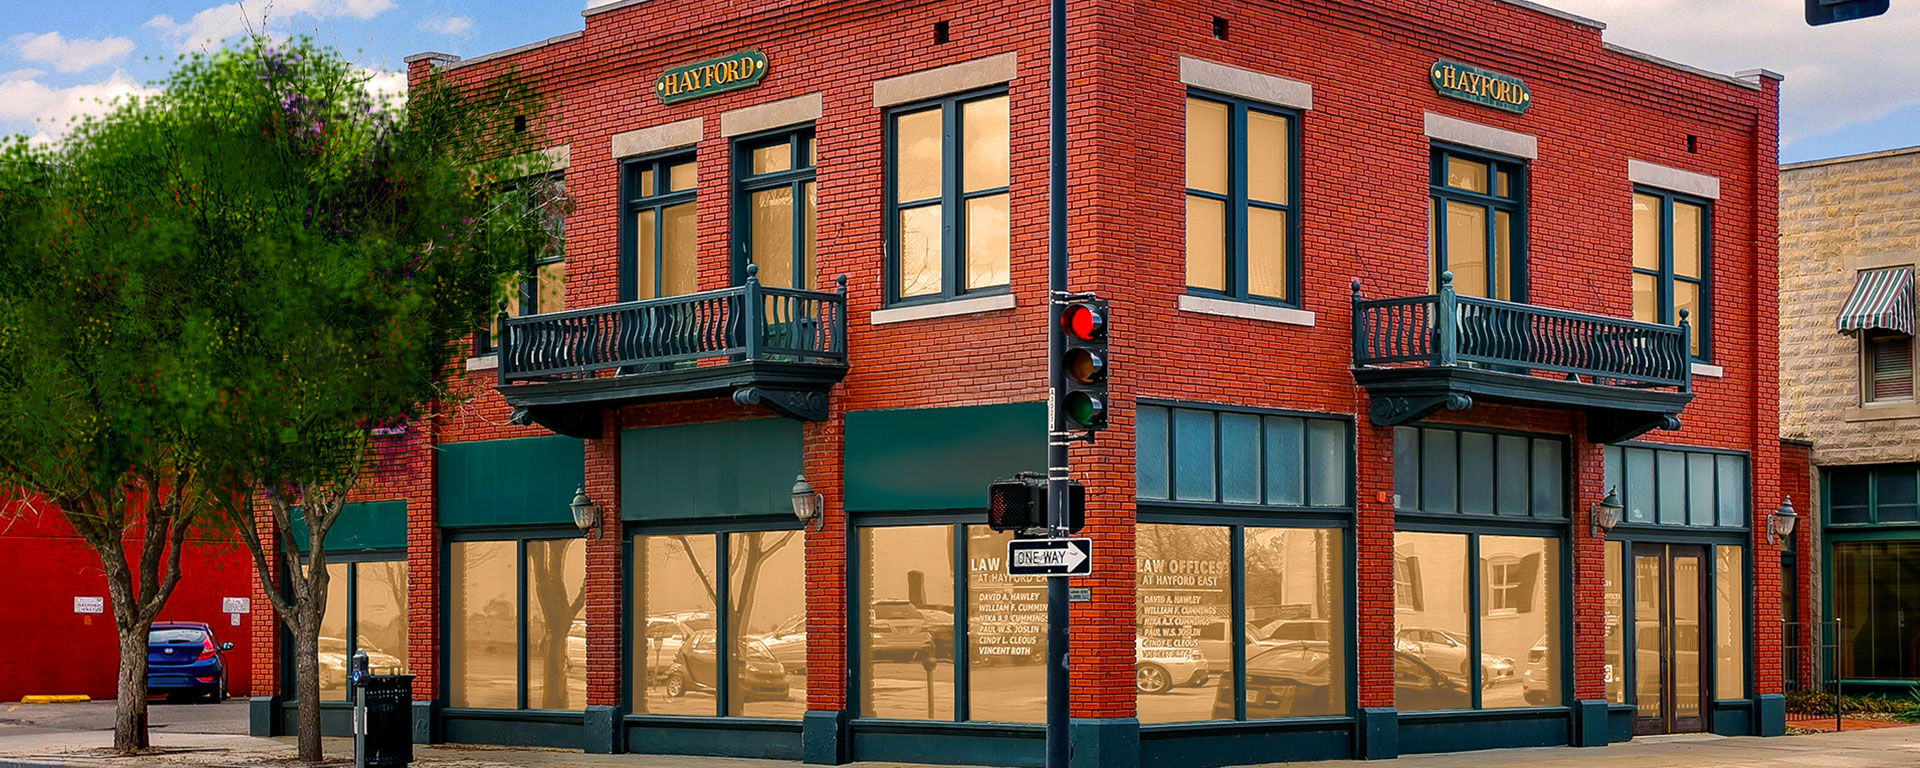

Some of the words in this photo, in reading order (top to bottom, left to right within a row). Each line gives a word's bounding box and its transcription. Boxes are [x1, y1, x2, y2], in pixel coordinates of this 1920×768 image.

[664, 57, 754, 96] HAYFORD
[1442, 65, 1524, 105] HAYFORD
[1017, 551, 1040, 565] ONE
[1044, 550, 1066, 564] WAY
[971, 558, 1000, 571] LAW
[1136, 560, 1165, 573] LAW
[1168, 560, 1225, 574] OFFICES
[977, 573, 988, 583] AT
[1142, 575, 1153, 585] AT
[1156, 576, 1195, 586] HAYFORD
[1197, 577, 1218, 586] EAST
[979, 593, 1001, 601] DAVID
[1002, 593, 1009, 601] A.
[1010, 592, 1040, 601] HAWLEY
[1144, 595, 1166, 604] DAVID
[1174, 595, 1201, 604] HAWLEY
[979, 603, 1009, 612] WILLIAM
[1018, 603, 1048, 612] CUMMIN
[1144, 606, 1173, 615] WILLIAM
[979, 625, 997, 634] PAUL
[1014, 625, 1040, 634] JOSLIN
[979, 636, 1000, 645] CINDY
[979, 646, 1010, 655] VINCENT
[1011, 646, 1031, 655] ROTH
